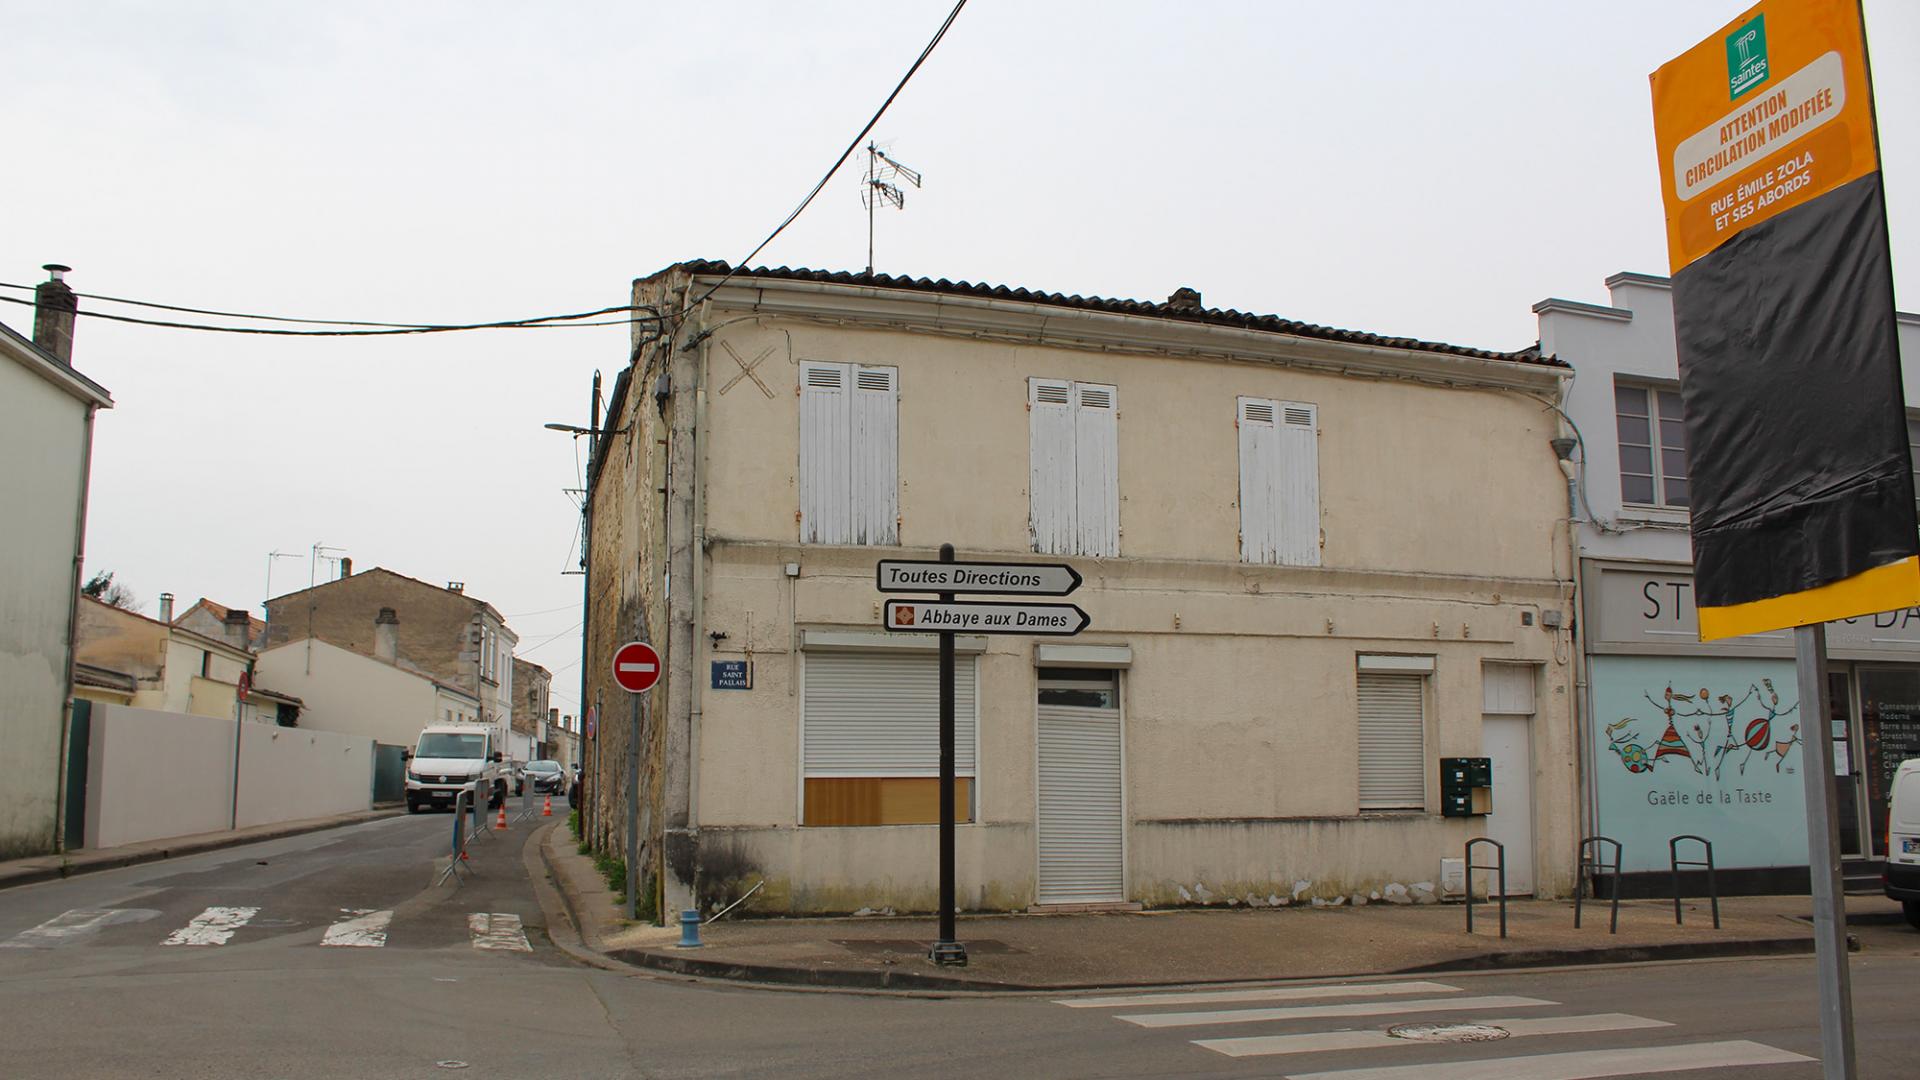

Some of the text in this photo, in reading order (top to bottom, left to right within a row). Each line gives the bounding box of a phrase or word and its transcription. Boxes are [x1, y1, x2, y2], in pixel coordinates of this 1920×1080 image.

[1685, 86, 1833, 188] CIRCULATION MODIFIÉE
[1720, 90, 1787, 145] ATTENTION
[1711, 151, 1814, 216] RUE ÉMILE ZOLA
[1715, 170, 1811, 231] ET SES ABORDS
[890, 568, 1041, 587] Toutes Directions
[921, 609, 1067, 628] Abbaye aux Dames
[1647, 788, 1772, 806] Gaële de la Taste
